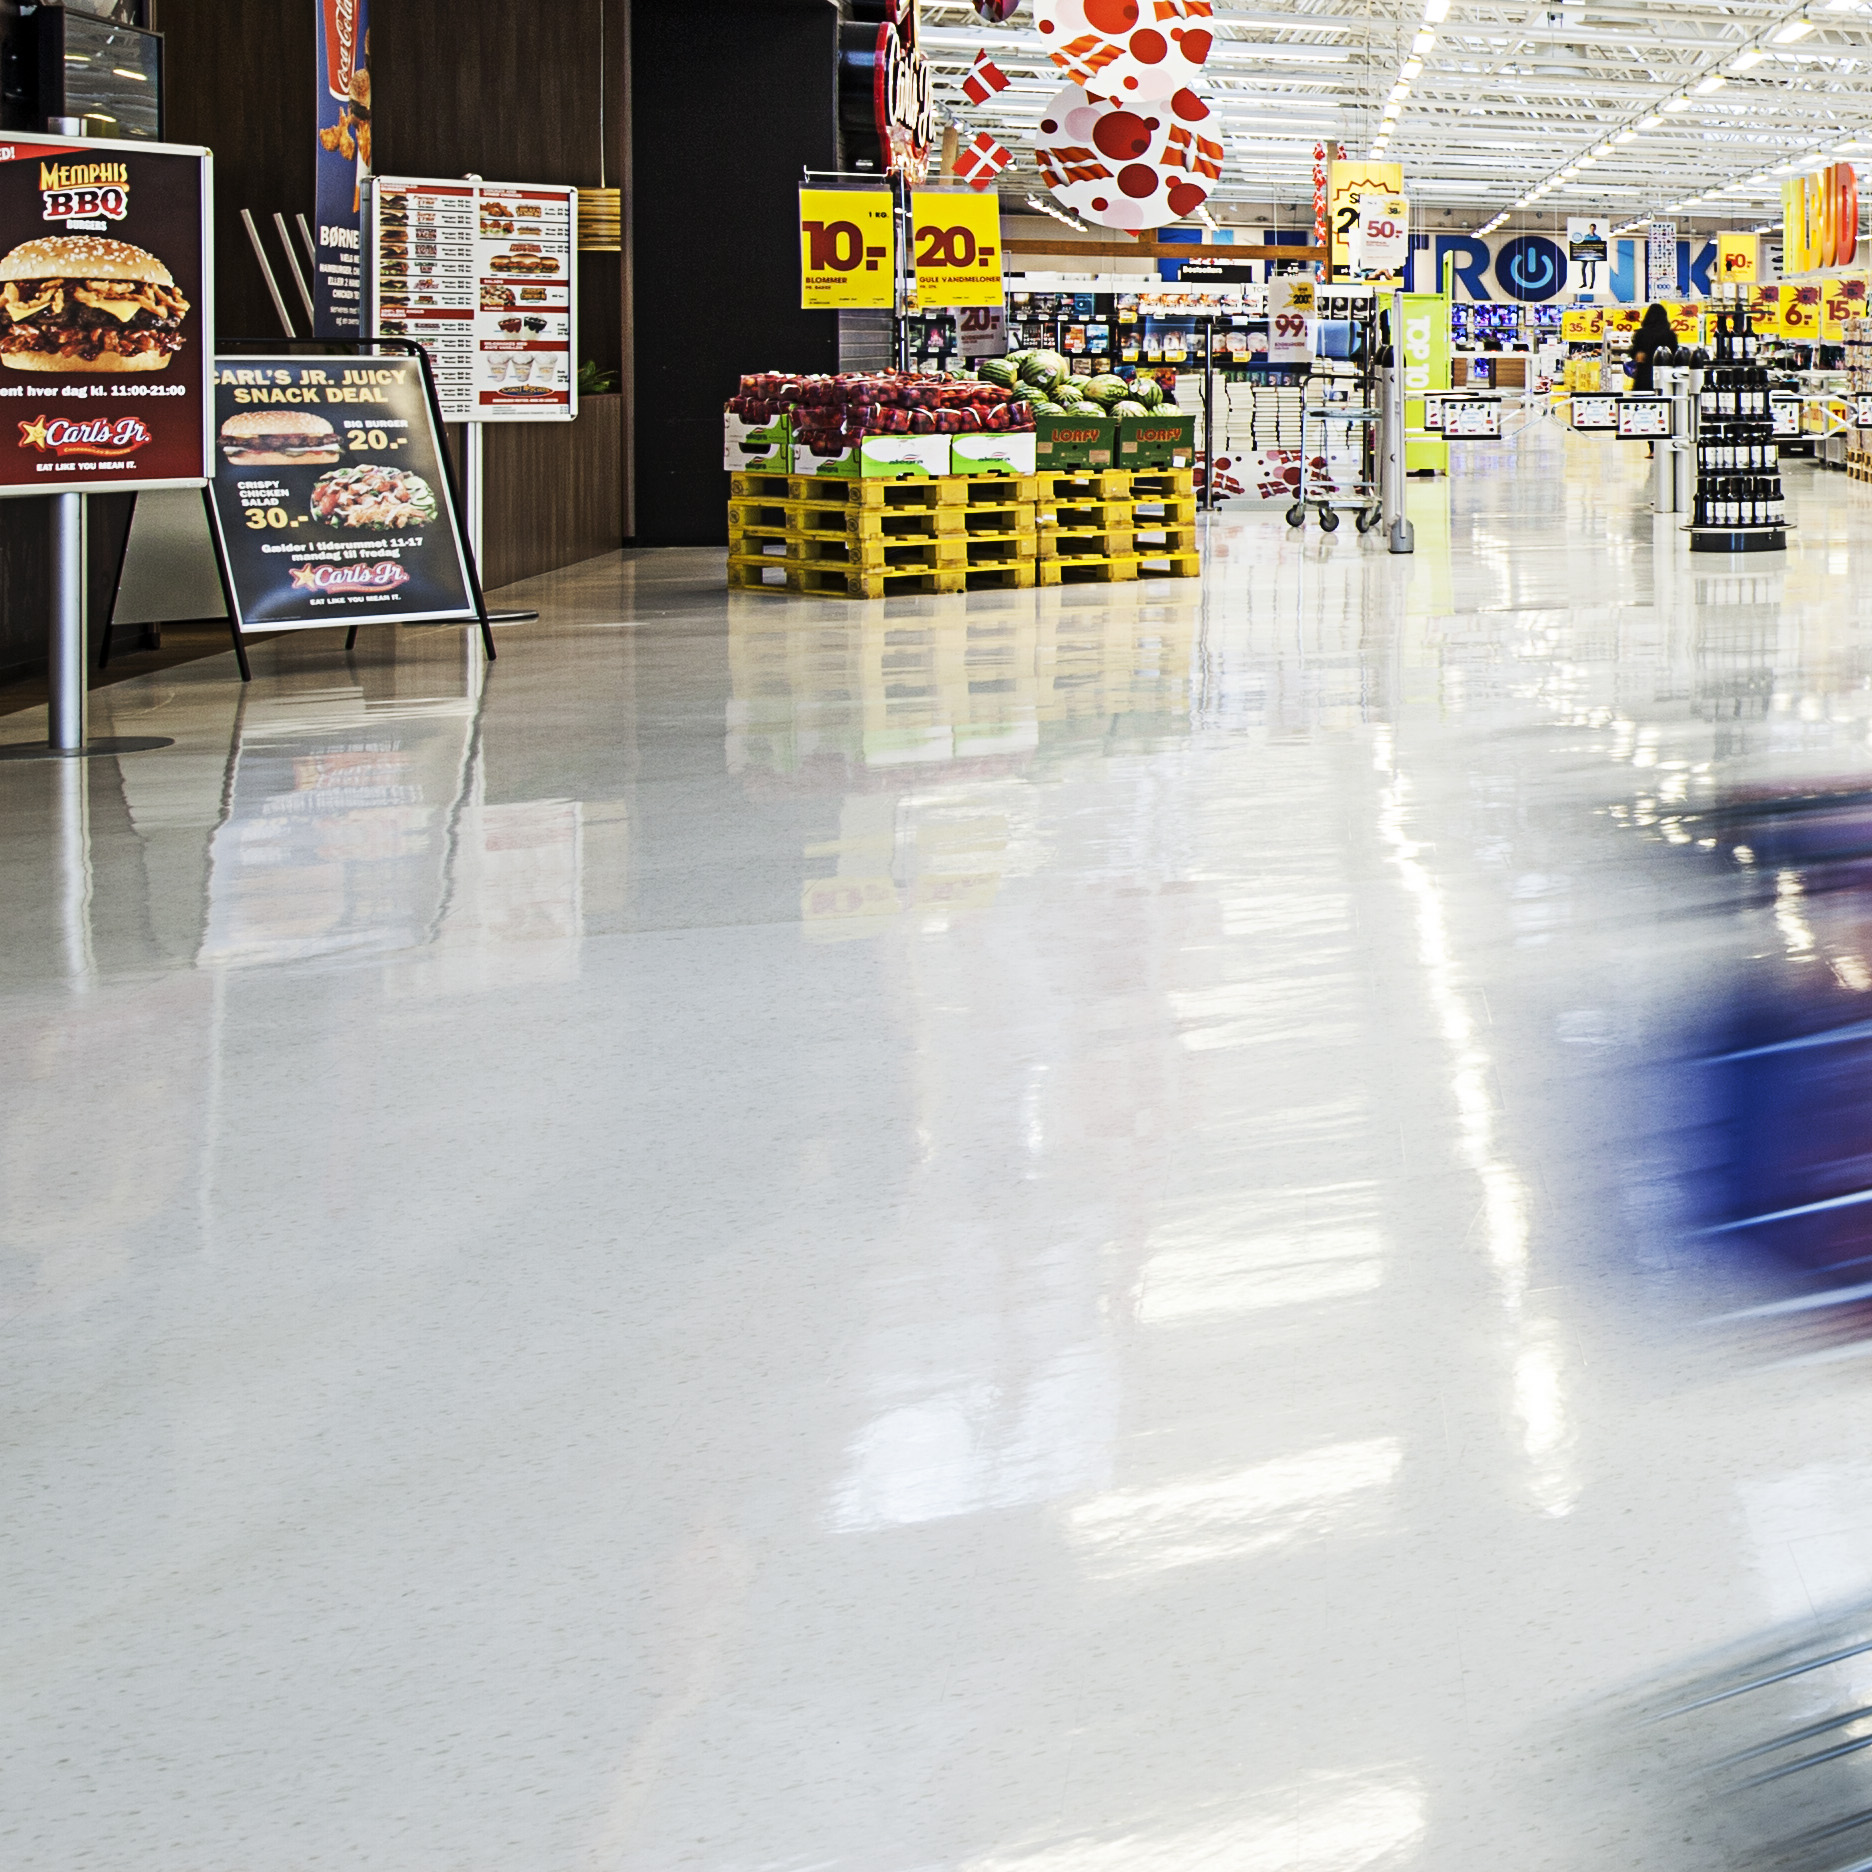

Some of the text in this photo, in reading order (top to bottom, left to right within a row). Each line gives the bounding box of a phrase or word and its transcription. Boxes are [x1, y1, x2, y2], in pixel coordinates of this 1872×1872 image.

[39, 161, 128, 190] MEMPHIS
[45, 187, 126, 218] BBQ
[1406, 315, 1431, 389] TOP 10
[300, 369, 334, 385] JR.
[342, 369, 407, 385] JUICY
[27, 385, 58, 397] hver
[61, 385, 88, 398] dag
[90, 385, 107, 397] kl.
[110, 385, 186, 397] 11:00-21:00
[234, 387, 388, 404] SNACK DEAL
[45, 419, 150, 446] Carl's Jr.
[36, 463, 53, 472] EAT
[237, 481, 280, 490] CRISPY
[239, 488, 290, 498] CHICKEN
[241, 497, 280, 507] SALAD
[261, 543, 306, 554] Gælder
[316, 540, 388, 551] tidsrummet
[390, 537, 423, 547] 11-17
[292, 548, 400, 562] mandag til fredag
[314, 563, 409, 586] Carl's Jr.
